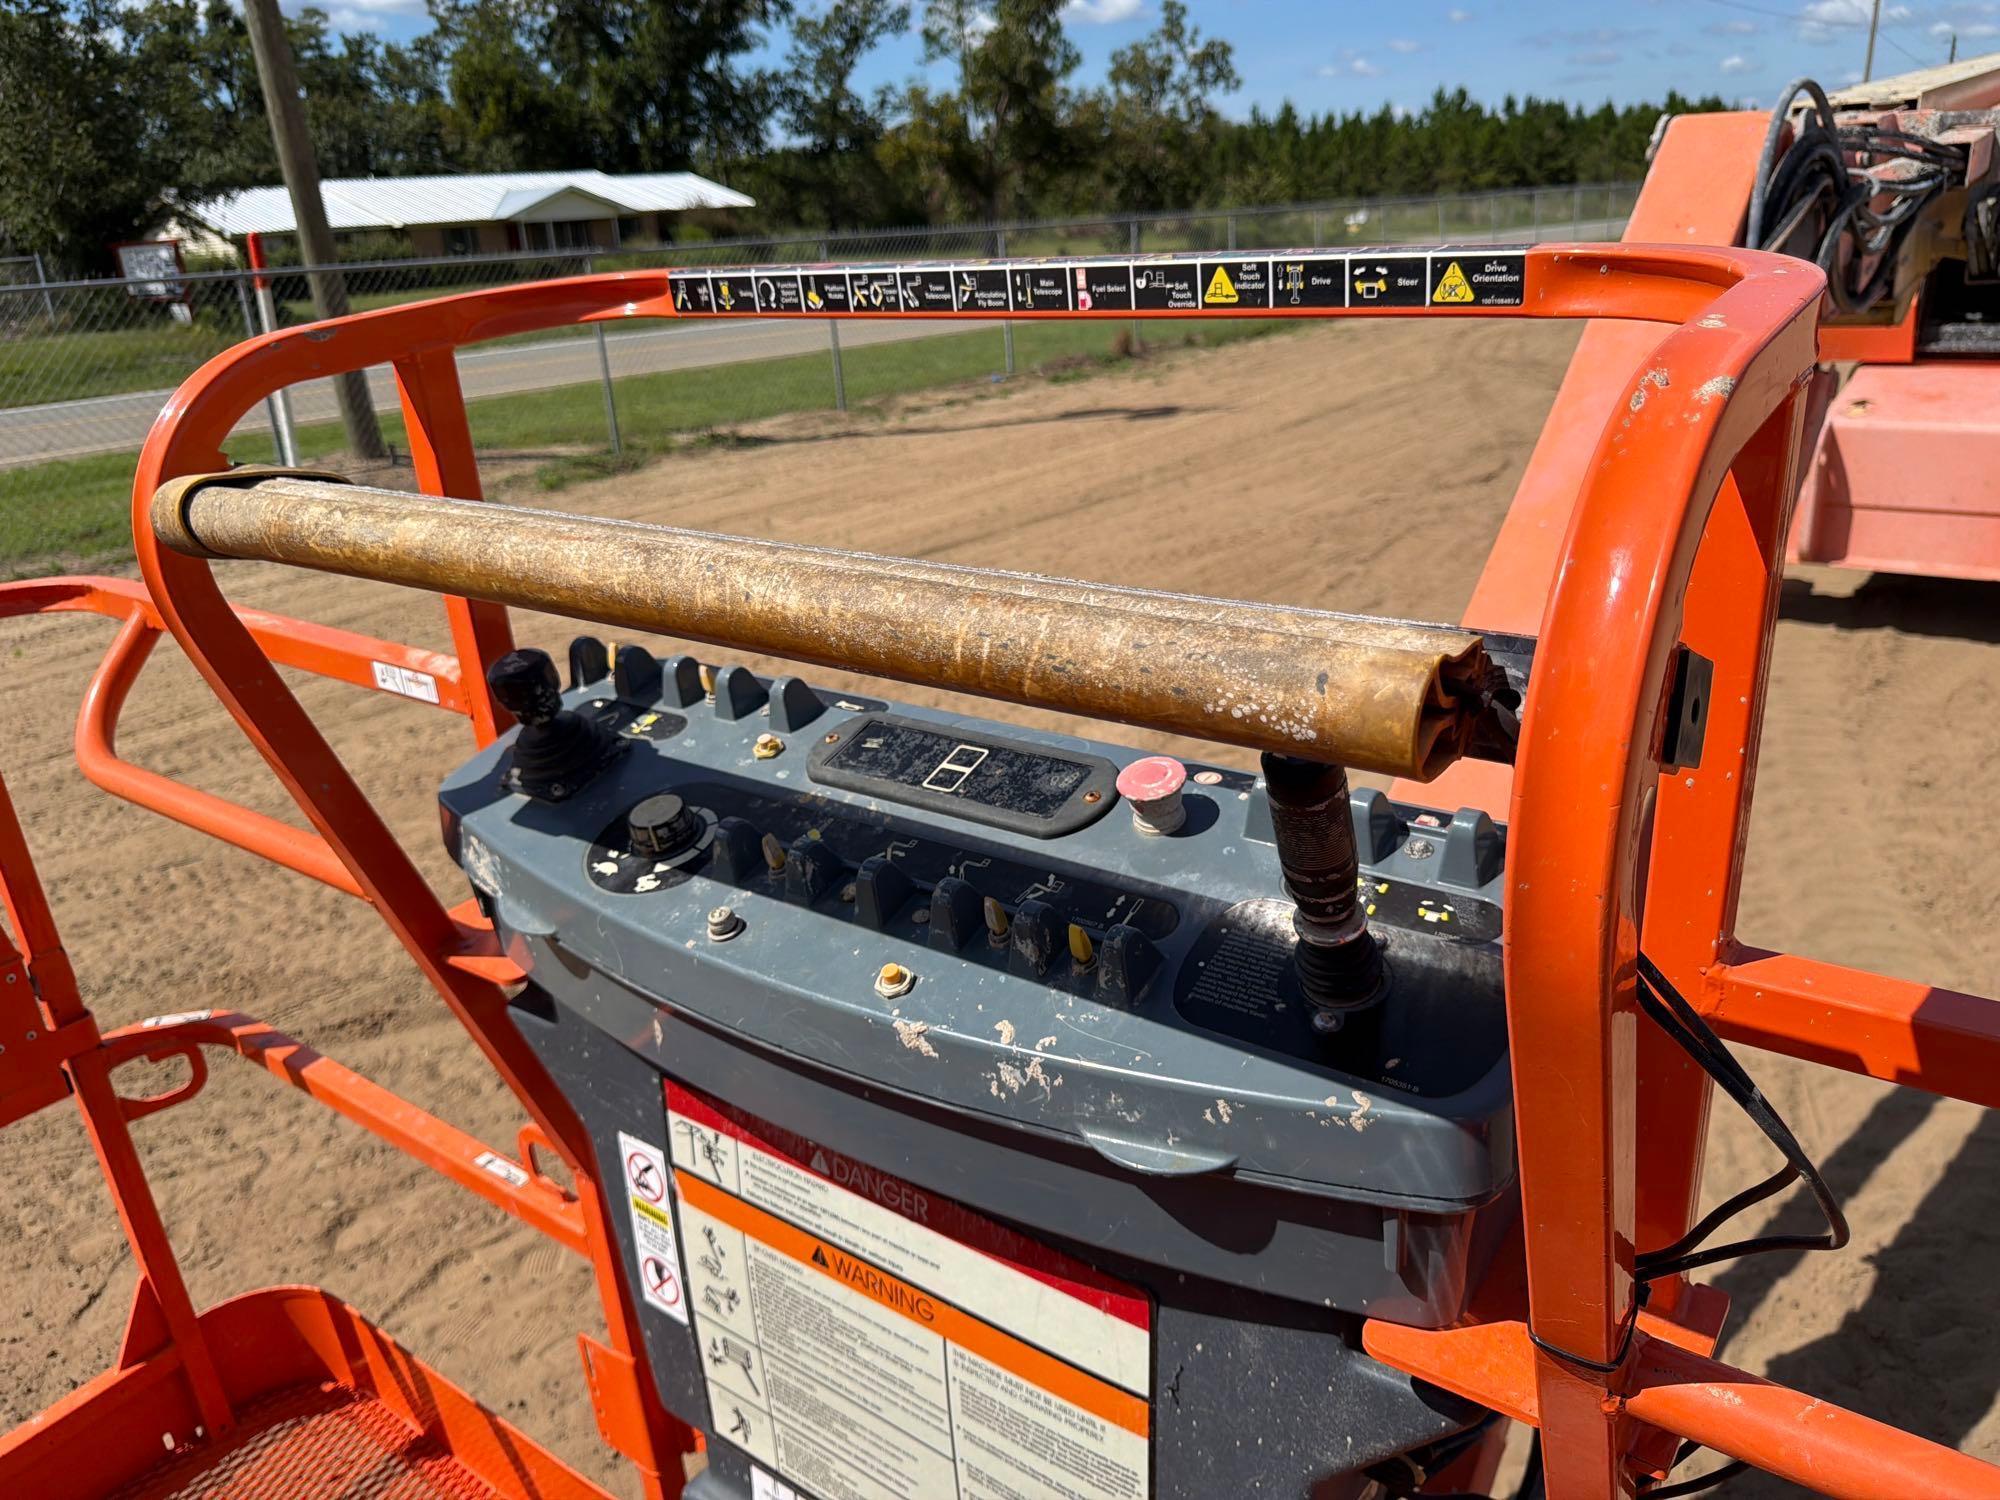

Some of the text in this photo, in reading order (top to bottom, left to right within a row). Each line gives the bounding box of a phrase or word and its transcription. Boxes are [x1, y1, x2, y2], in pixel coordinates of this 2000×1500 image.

[1485, 264, 1507, 273] Drive
[1239, 272, 1260, 281] Touch
[1472, 273, 1519, 283] Orientation
[1040, 279, 1054, 287] Main
[1174, 282, 1188, 290] Soft
[1234, 281, 1265, 290] Indicator
[1311, 277, 1331, 286] Drive
[1397, 277, 1418, 286] Steer
[1033, 287, 1063, 297] Telescope
[1092, 284, 1126, 293] Fuel Select
[975, 291, 1006, 301] Articulating
[1171, 291, 1192, 300] Touch
[978, 299, 1004, 308] Fly Boom
[1168, 300, 1196, 308] Override
[833, 1157, 929, 1222] DANGER
[832, 1253, 934, 1322] WARNING
